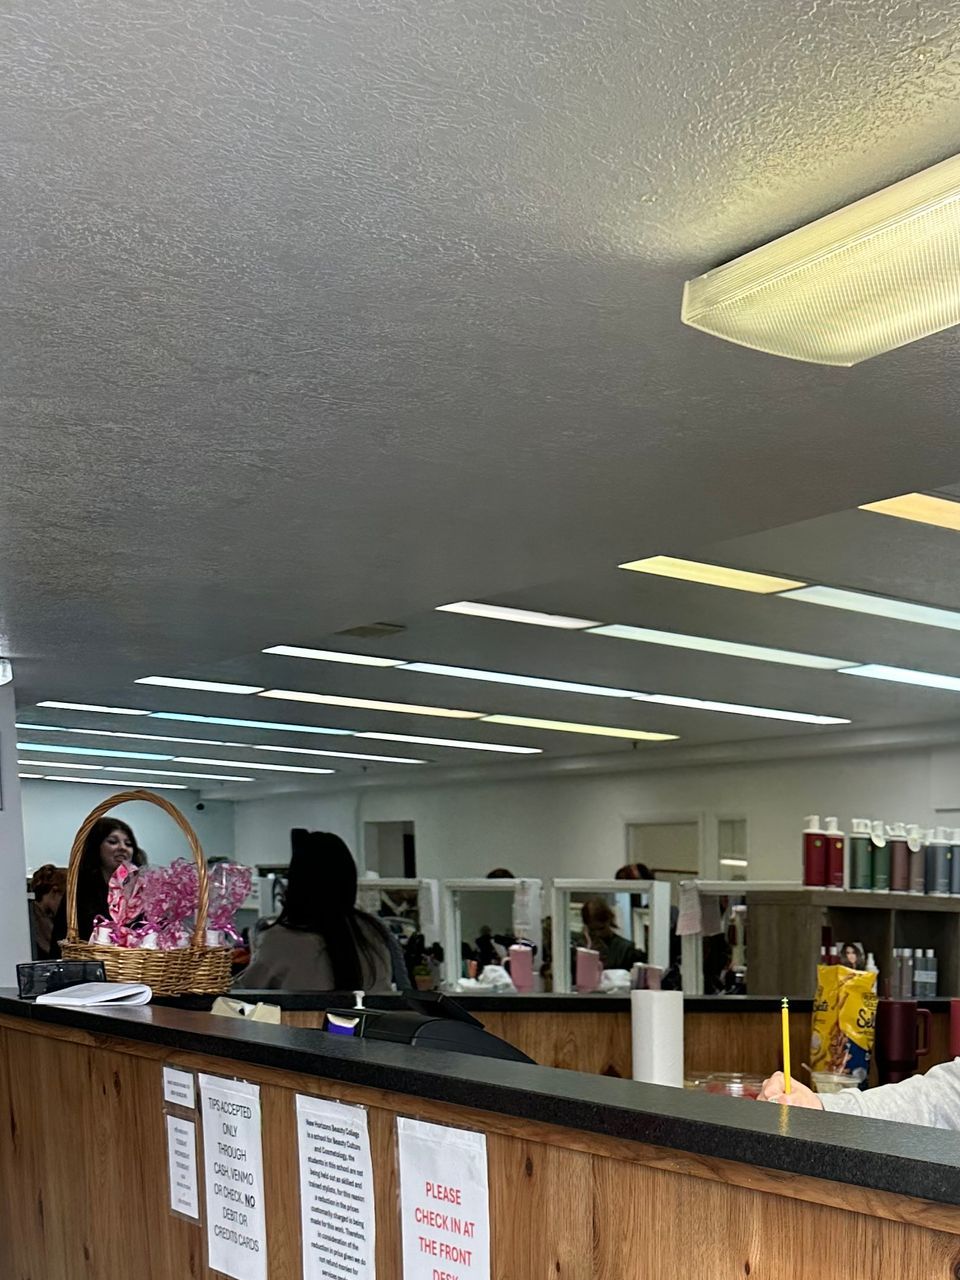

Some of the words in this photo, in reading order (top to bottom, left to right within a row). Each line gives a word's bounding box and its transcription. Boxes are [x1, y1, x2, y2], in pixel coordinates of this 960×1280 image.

[208, 1097, 220, 1112] TIPS
[220, 1100, 252, 1119] ACCEPTED
[222, 1122, 238, 1137] ONLY
[314, 1133, 326, 1141] school
[218, 1142, 246, 1161] THROUGH
[230, 1168, 254, 1186] VENMO
[337, 1164, 349, 1172] school
[214, 1183, 222, 1196] OR
[244, 1194, 256, 1208] NO
[426, 1182, 461, 1206] PLEASE
[222, 1206, 238, 1222] DEBIT
[239, 1212, 248, 1226] OR
[414, 1208, 448, 1231] CHECK
[451, 1217, 461, 1235] IN
[464, 1221, 475, 1238] AT
[214, 1224, 238, 1244] CREDITS
[238, 1234, 259, 1252] CARDS
[418, 1236, 437, 1256] THE
[440, 1243, 472, 1266] FRONT
